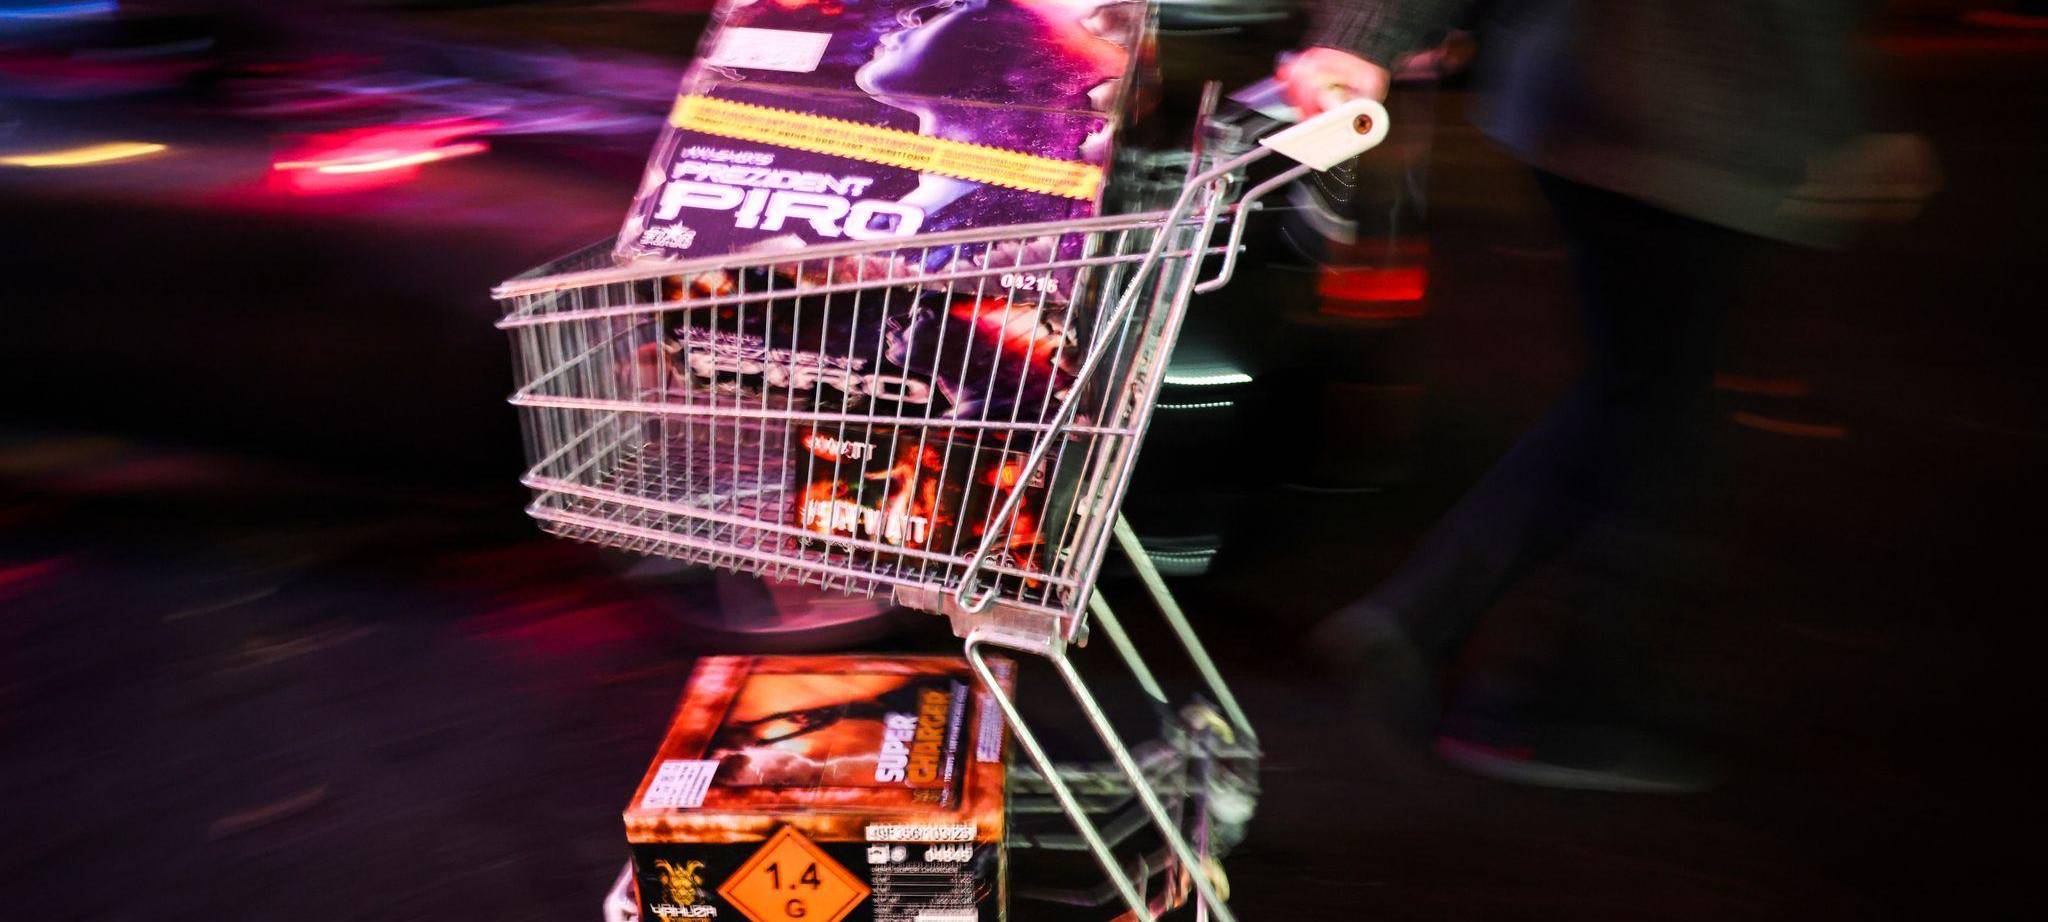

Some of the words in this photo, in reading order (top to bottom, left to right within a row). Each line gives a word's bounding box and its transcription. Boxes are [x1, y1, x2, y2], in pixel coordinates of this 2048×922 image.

[671, 161, 874, 197] PREZIDENT
[654, 180, 926, 241] PIRO
[875, 712, 919, 783] SUPER
[907, 689, 951, 784] CHARGER
[765, 862, 821, 890] 1.4
[784, 898, 806, 918] G
